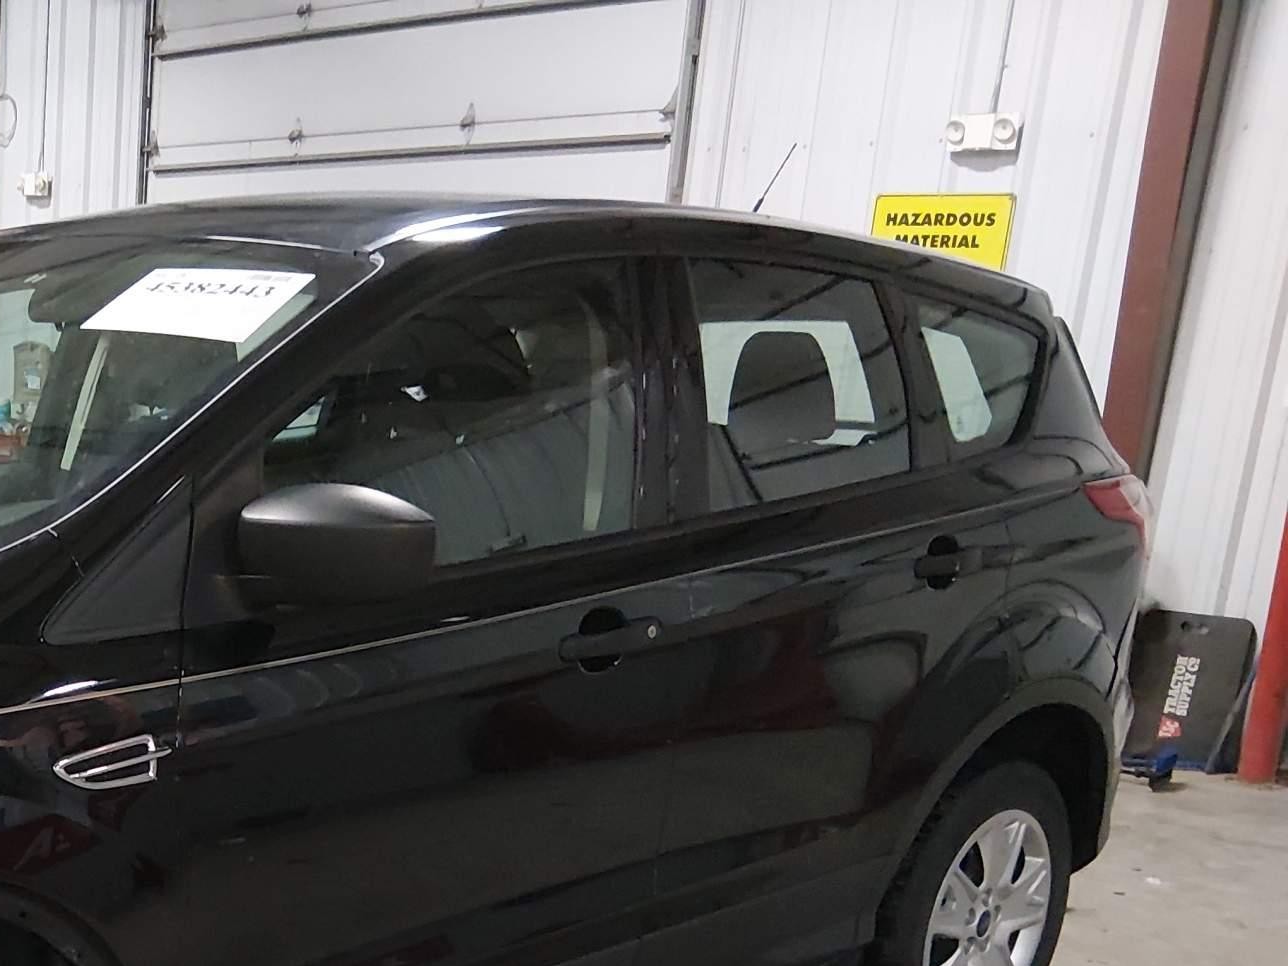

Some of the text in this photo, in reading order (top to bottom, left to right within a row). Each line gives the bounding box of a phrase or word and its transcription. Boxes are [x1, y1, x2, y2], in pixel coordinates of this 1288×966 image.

[885, 212, 997, 227] HAZARDOUS
[146, 281, 275, 298] 45382443
[1163, 655, 1188, 714] TRACTOR
[1175, 674, 1197, 717] SUPPLY
